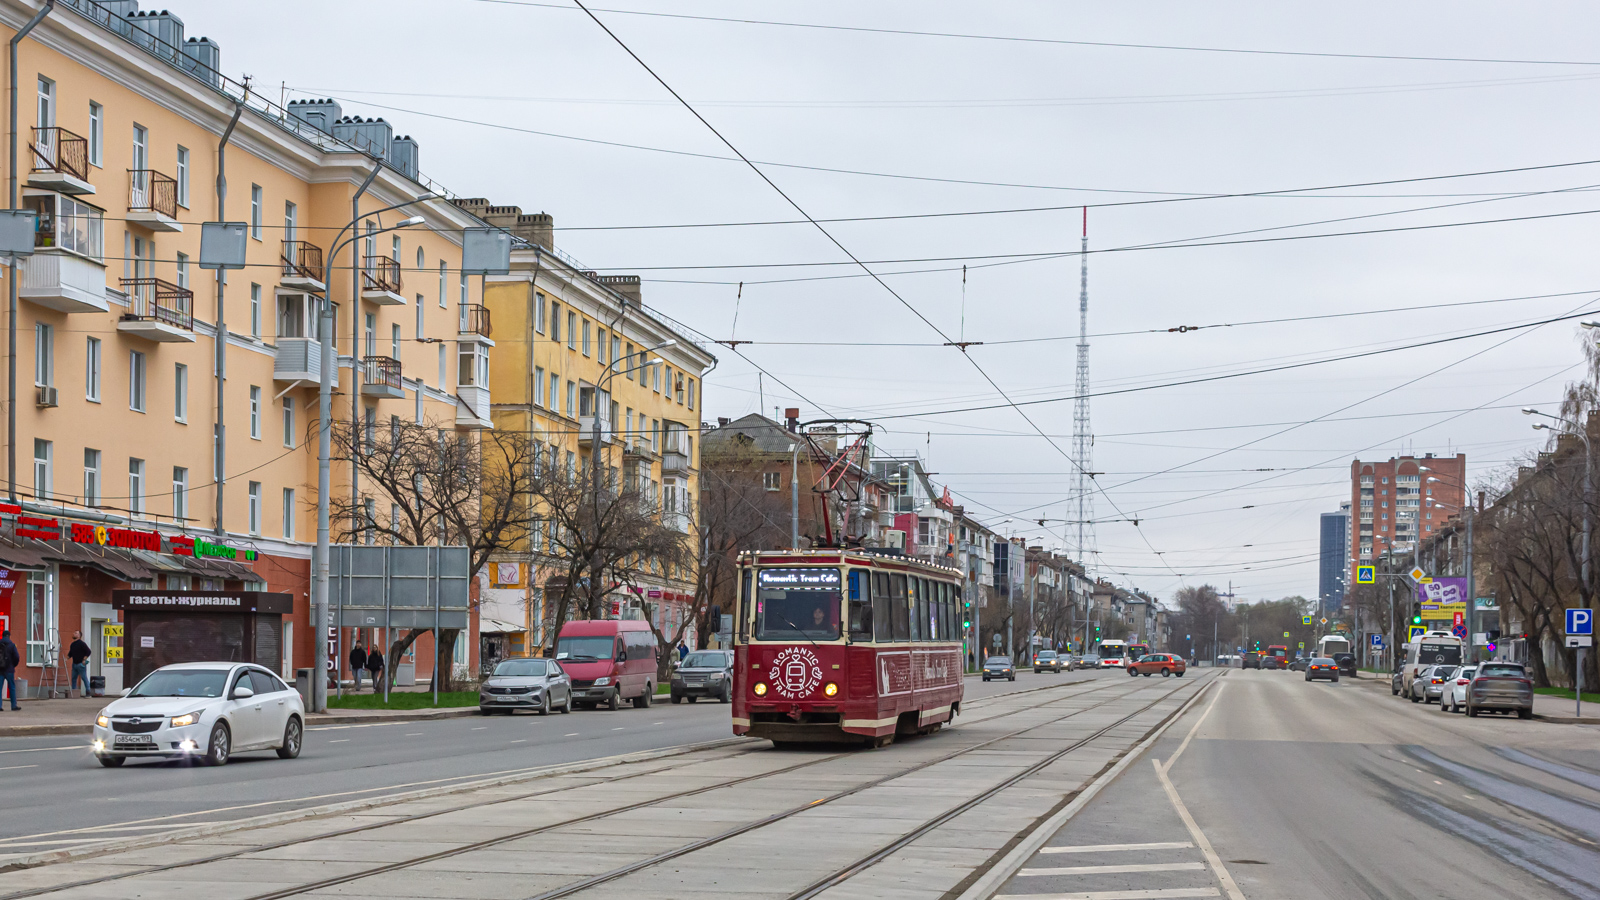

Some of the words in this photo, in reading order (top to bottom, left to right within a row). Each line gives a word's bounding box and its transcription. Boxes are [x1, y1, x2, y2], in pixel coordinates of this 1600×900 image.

[71, 523, 94, 544] 585
[763, 574, 798, 582] Romantic
[800, 574, 820, 582] Tram
[1573, 611, 1589, 632] P
[773, 646, 819, 666] ROMANTIC
[773, 680, 795, 699] TRAM
[798, 680, 820, 699] CAFE
